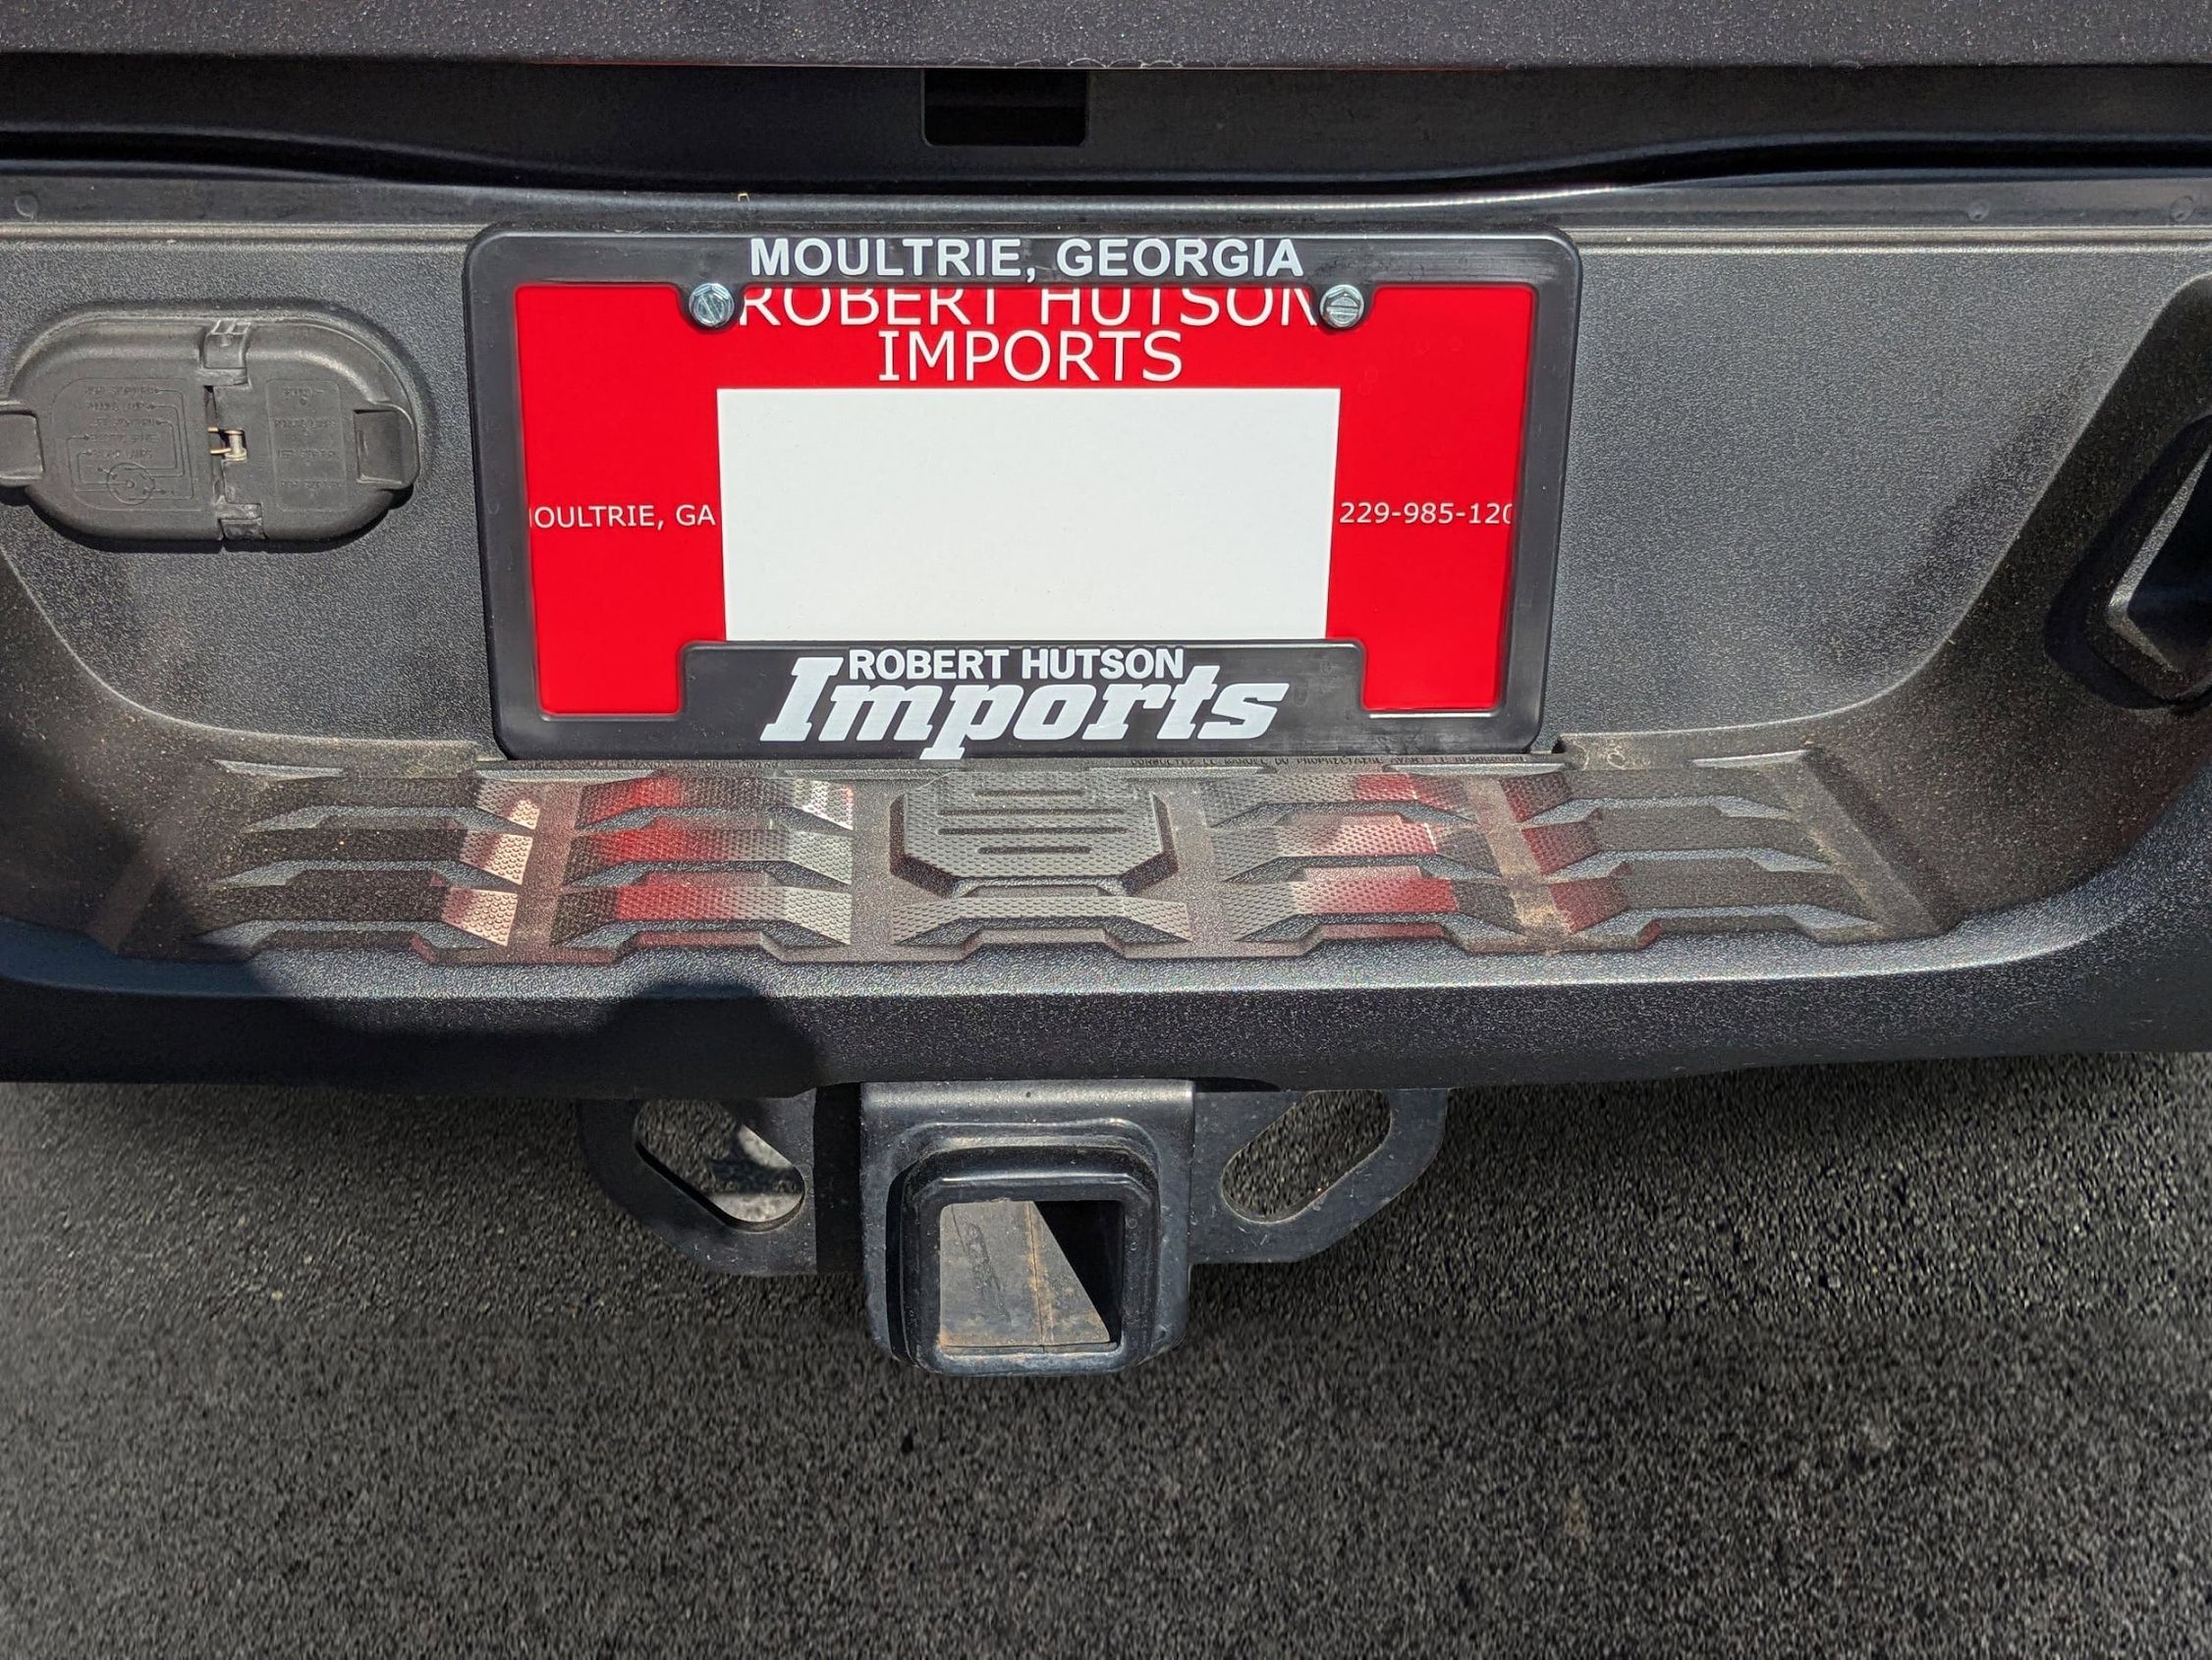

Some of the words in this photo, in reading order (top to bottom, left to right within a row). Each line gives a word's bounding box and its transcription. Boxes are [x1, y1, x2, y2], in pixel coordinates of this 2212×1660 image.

[750, 238, 1035, 283] MOULTRIE,
[1057, 238, 1303, 277] GEORGIA
[739, 287, 995, 326] ROBERT
[1040, 287, 1318, 327] HUTSON
[878, 330, 1183, 382] IMPORTS
[528, 504, 664, 530] OULTRIE,
[676, 504, 716, 526] GA
[1339, 501, 1513, 525] 229-985-120
[849, 648, 1009, 680] ROBERT
[1021, 648, 1185, 680] HUTSON
[759, 657, 1290, 760] Imports
